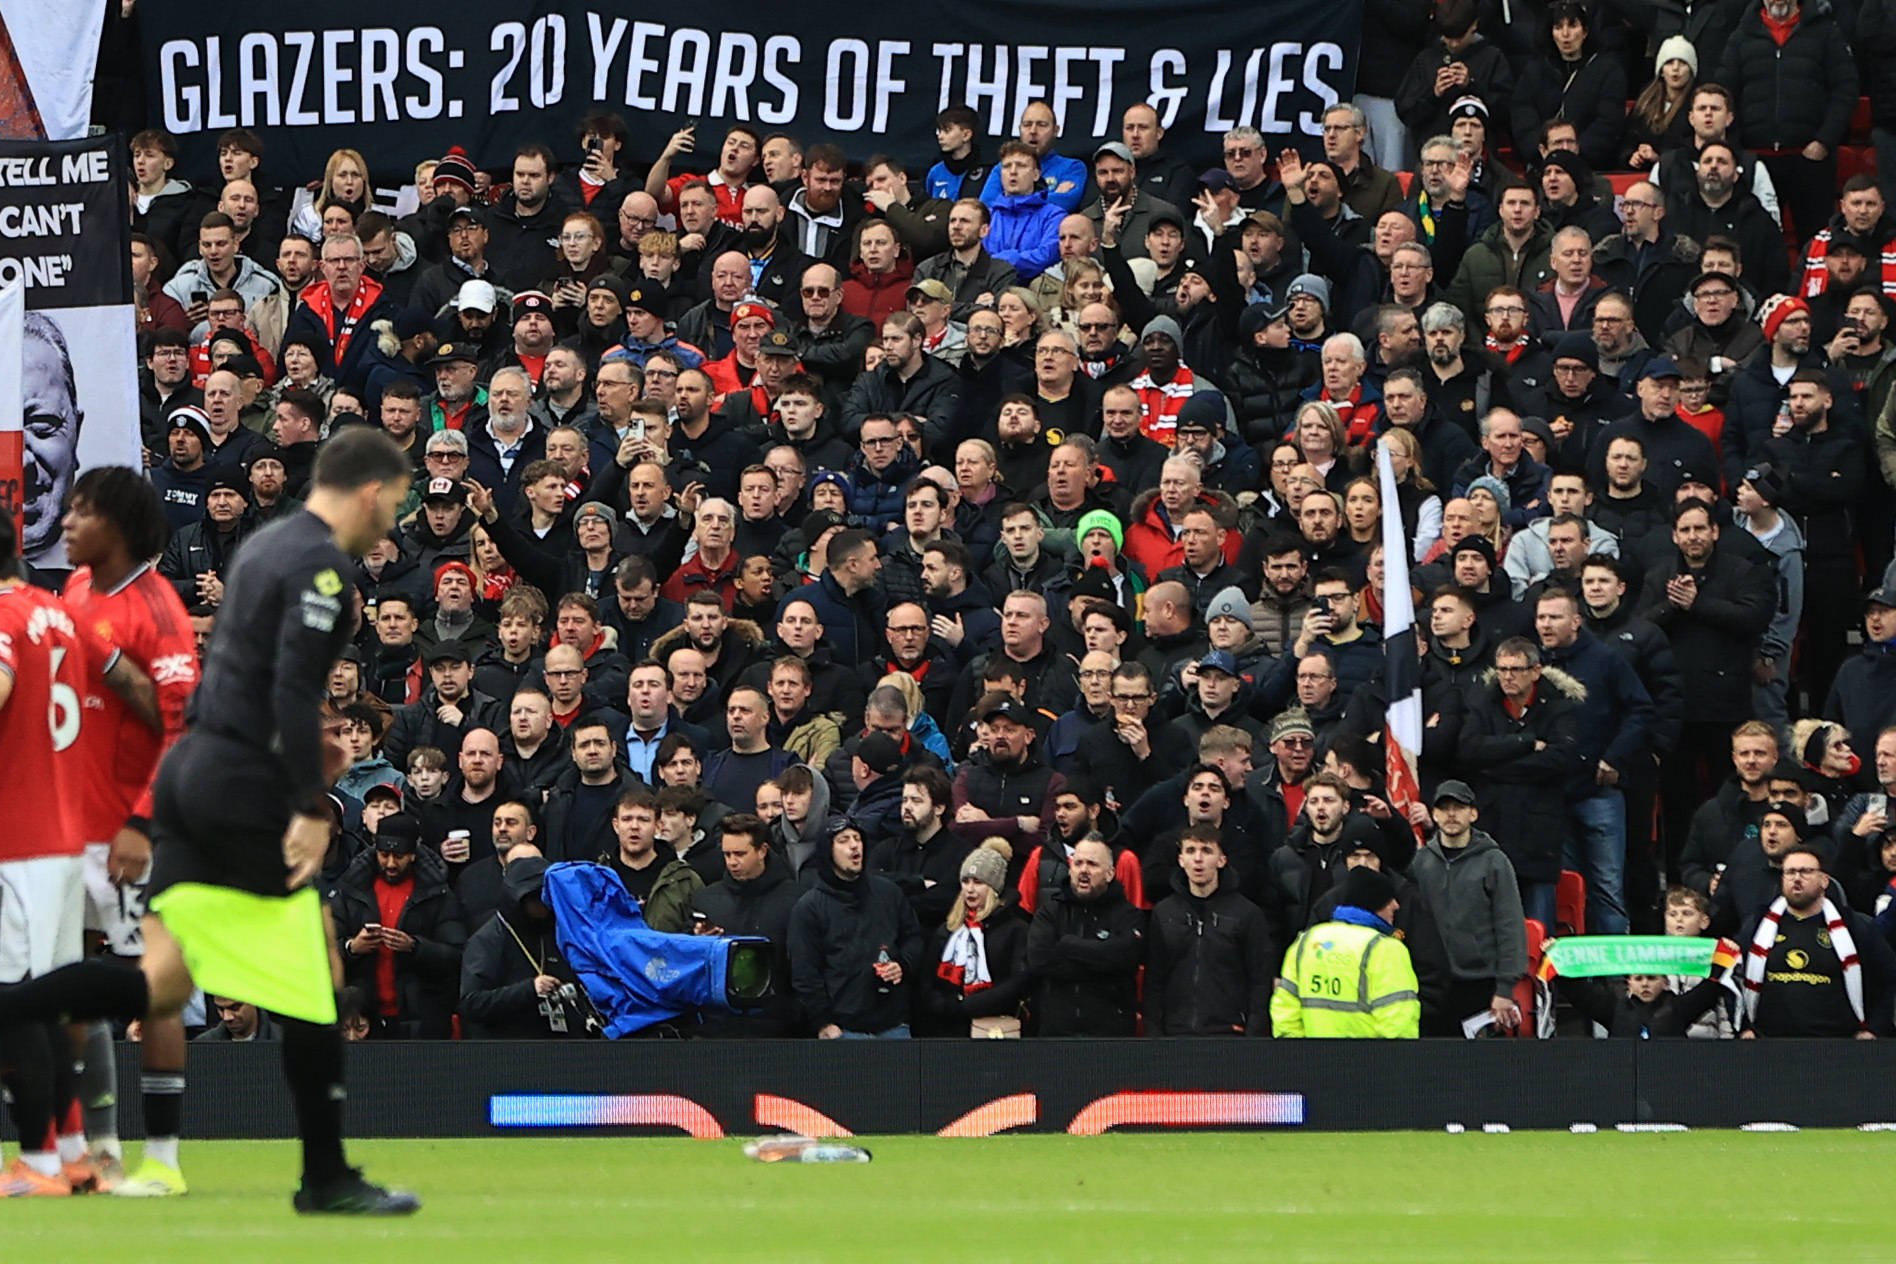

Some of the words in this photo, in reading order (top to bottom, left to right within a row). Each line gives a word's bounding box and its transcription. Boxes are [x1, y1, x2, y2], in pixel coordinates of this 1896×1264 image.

[159, 26, 465, 135] GLAZERS:
[489, 12, 567, 116] 20
[585, 11, 802, 125] YEARS
[822, 37, 911, 134] OF
[931, 42, 1126, 138] THEFT
[1145, 48, 1187, 130] &
[1203, 41, 1344, 136] LIES
[61, 150, 111, 183] ME
[166, 489, 199, 506] TOMMY
[48, 646, 82, 752] 6
[1311, 974, 1342, 996] 510
